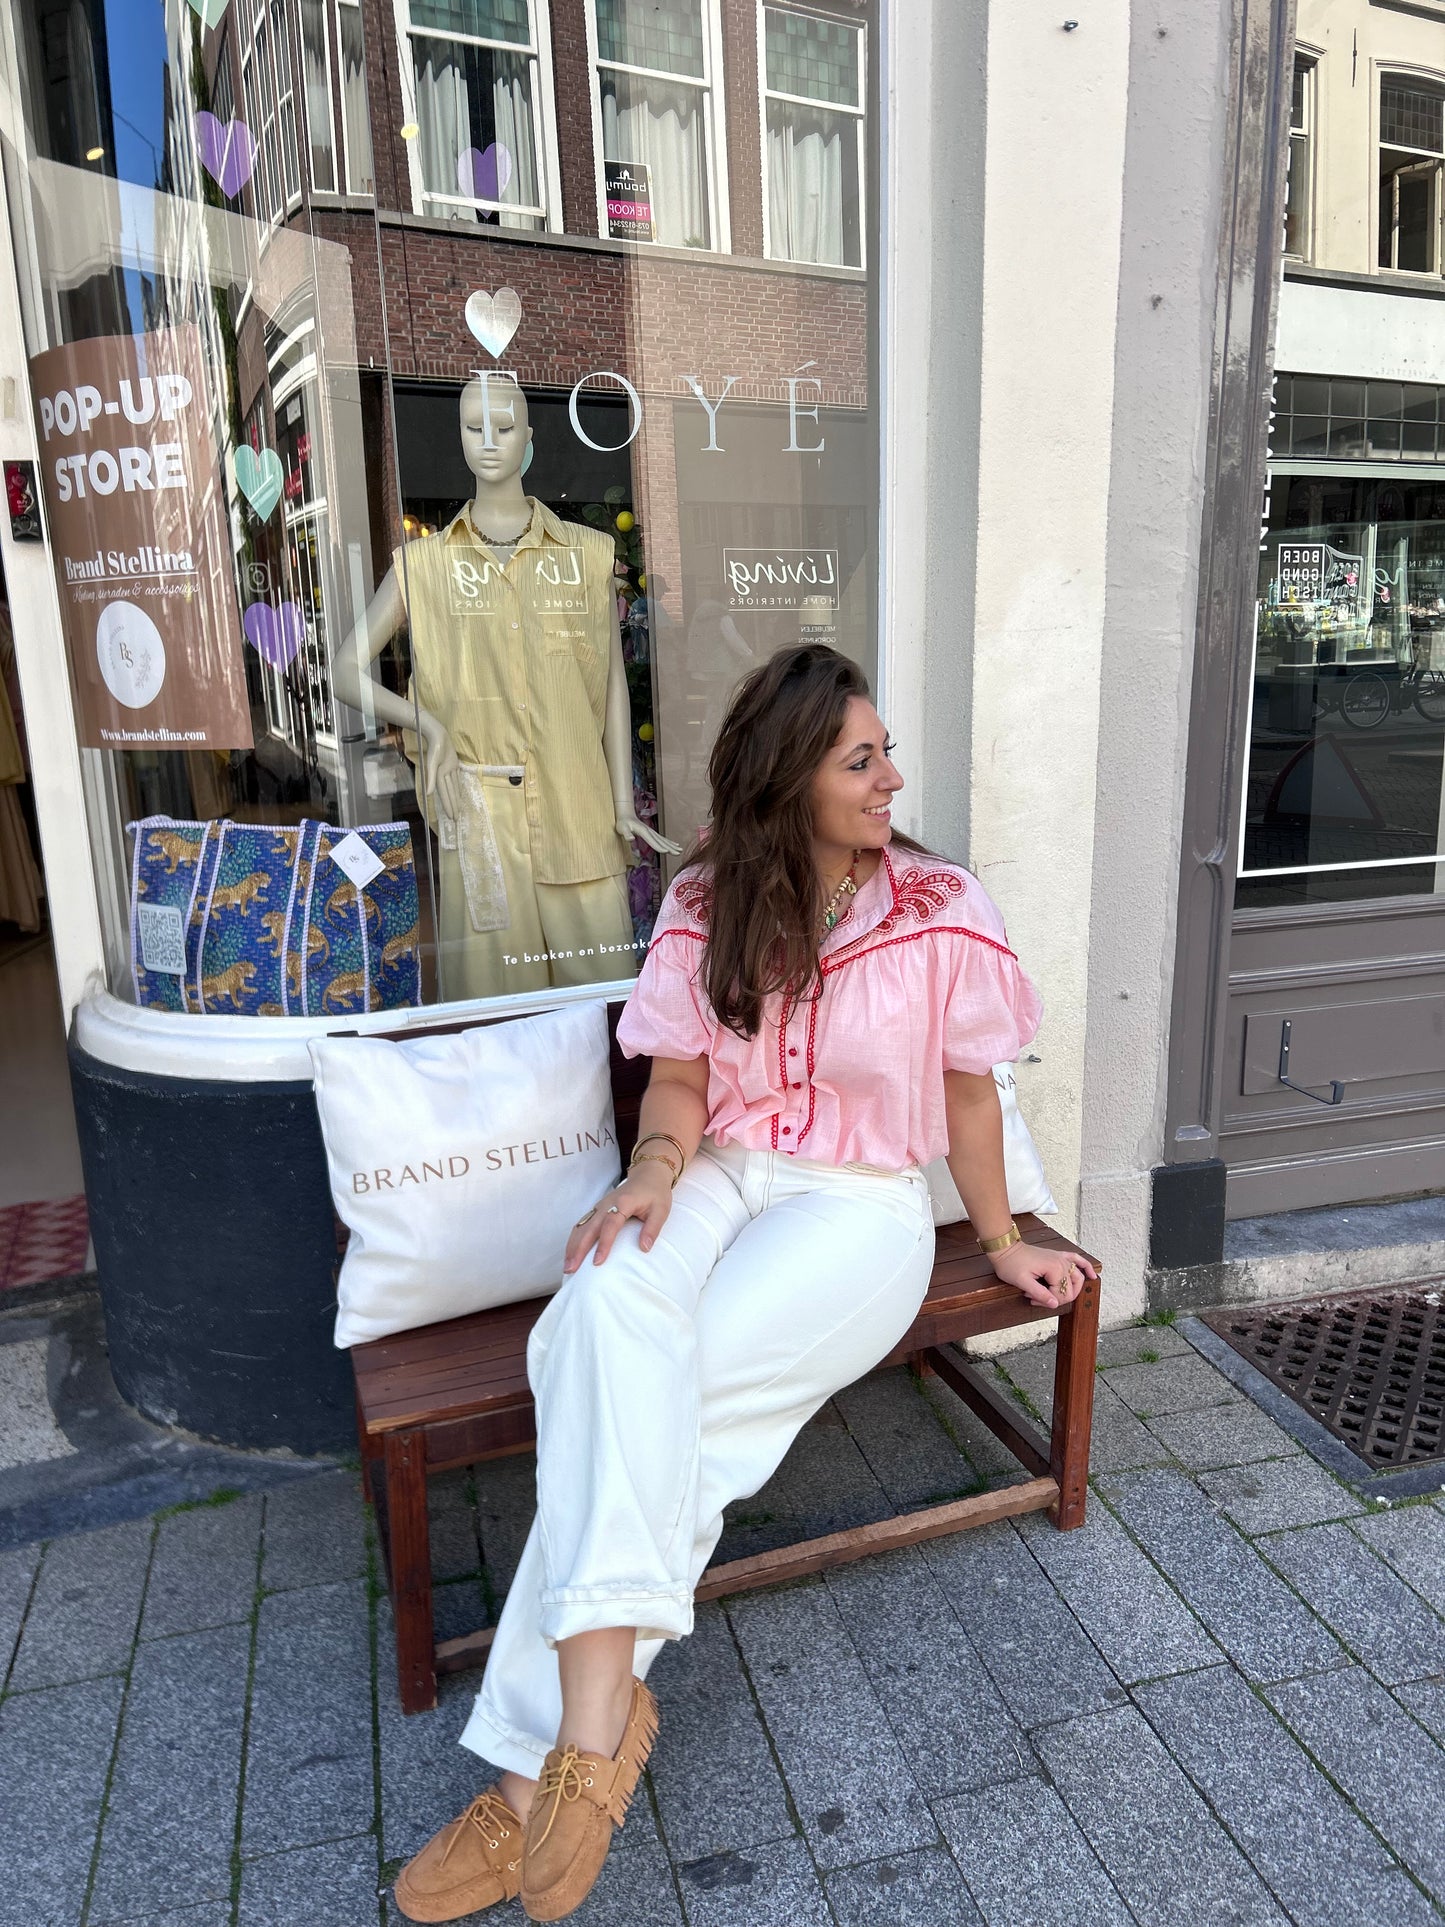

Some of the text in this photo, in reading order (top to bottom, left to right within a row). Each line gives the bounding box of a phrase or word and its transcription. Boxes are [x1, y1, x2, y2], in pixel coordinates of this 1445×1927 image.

[39, 374, 193, 442] POP-UP
[55, 442, 188, 503] STORE
[64, 546, 196, 580] Brand Stellina
[131, 581, 142, 599] &
[502, 955, 518, 965] Te
[524, 949, 573, 963] boeken
[578, 948, 594, 957] en
[352, 1127, 616, 1195] BRAND STELLINA
